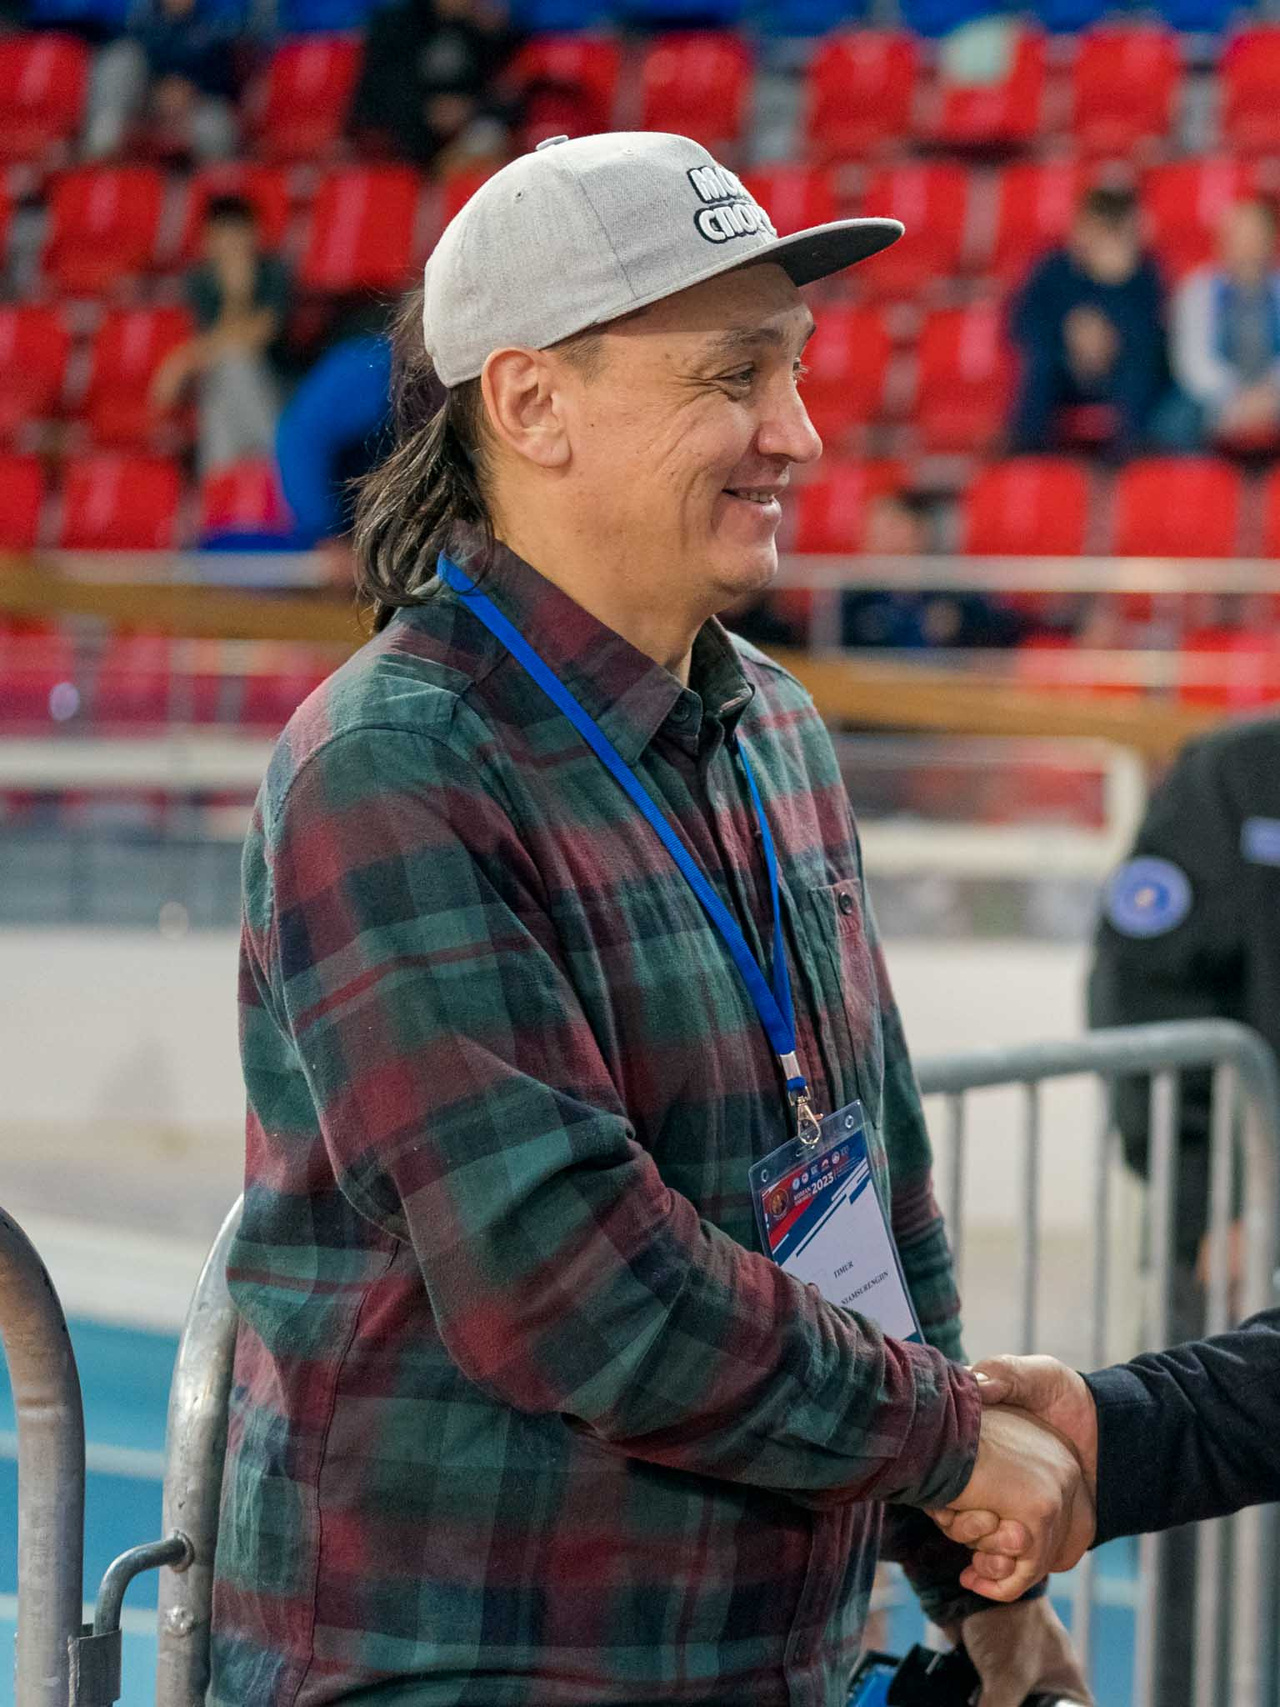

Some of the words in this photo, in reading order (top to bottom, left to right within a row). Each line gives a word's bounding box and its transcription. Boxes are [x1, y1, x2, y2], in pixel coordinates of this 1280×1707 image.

[689, 166, 744, 201] МО
[811, 1171, 834, 1195] 2023
[833, 1261, 855, 1279] TIMUR
